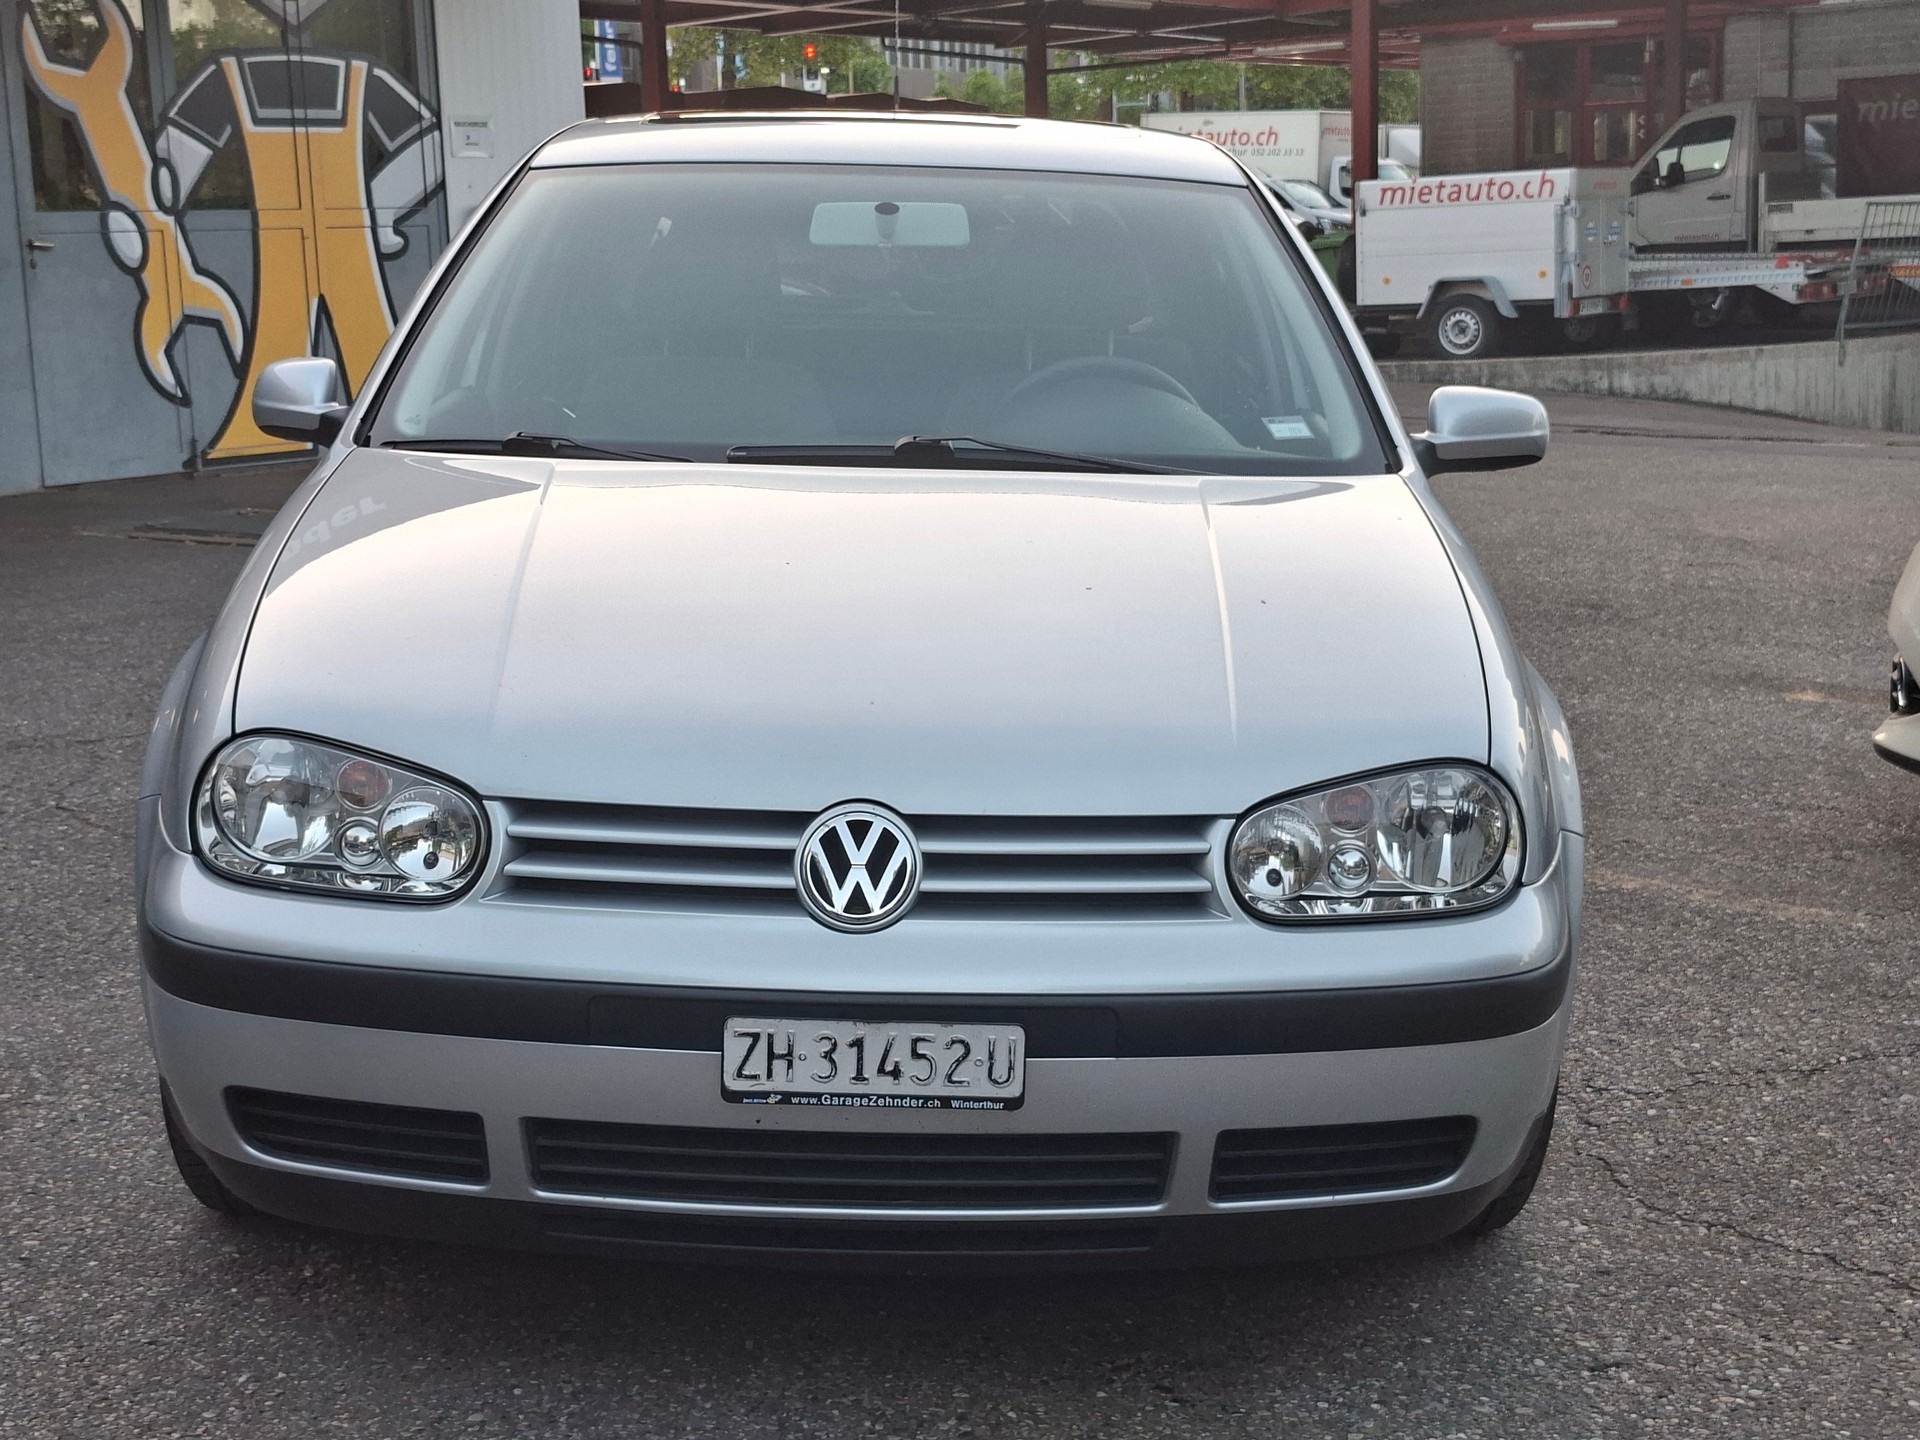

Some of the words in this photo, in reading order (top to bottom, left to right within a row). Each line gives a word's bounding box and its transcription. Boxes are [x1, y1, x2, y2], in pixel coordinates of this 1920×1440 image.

[1378, 170, 1555, 205] mietauto.ch
[791, 1094, 941, 1108] www.GarageZehnder.ch
[950, 1099, 1005, 1109] Winterthur
